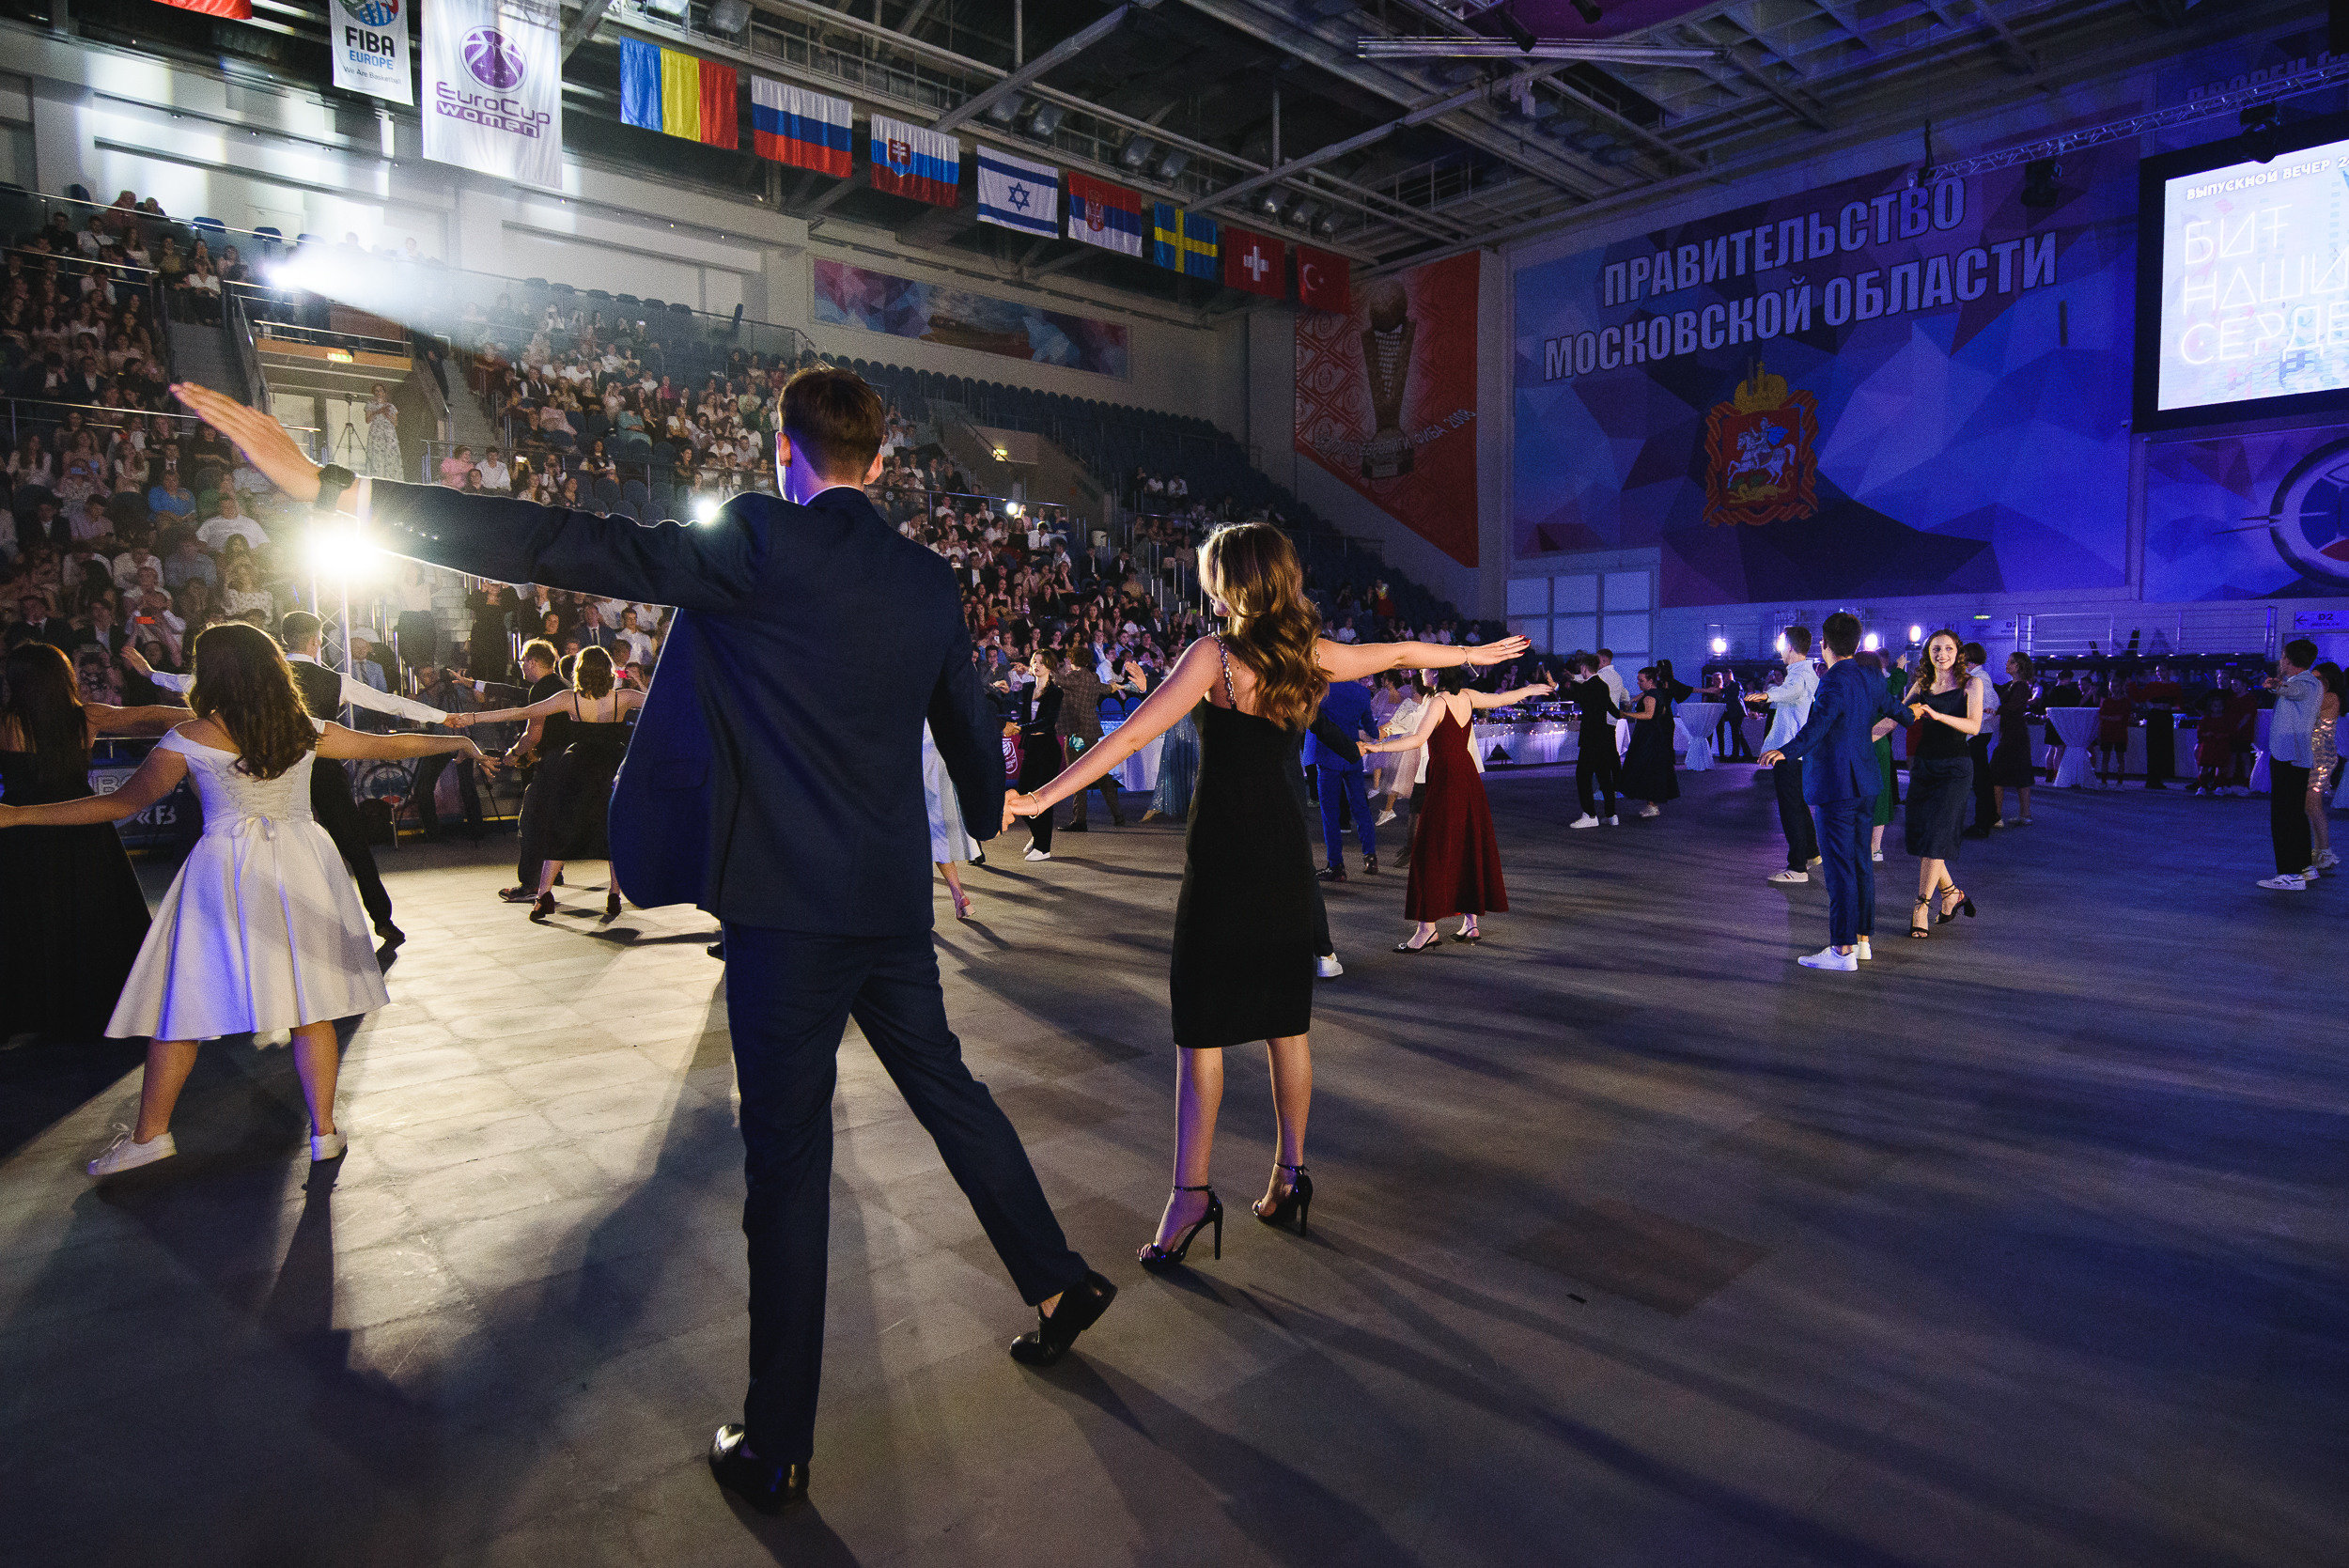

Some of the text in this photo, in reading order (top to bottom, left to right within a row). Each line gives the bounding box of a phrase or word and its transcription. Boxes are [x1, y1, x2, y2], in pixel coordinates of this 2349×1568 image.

[345, 25, 395, 57] FIBA
[350, 50, 394, 70] EUROPE
[343, 65, 401, 85] We Are Basketball
[437, 81, 551, 125] EuroCup
[439, 101, 538, 138] women
[2186, 156, 2349, 201] ВЫПУСКНОЙ ВЕЧЕР 2
[1604, 177, 1966, 306] ПРАВИТЕЛЬСТВО
[2185, 204, 2293, 265] БИТ
[2183, 245, 2349, 317] НАШИ
[1544, 231, 2057, 381] МОСКОВСКОЙ ОБЛАСТИ
[1359, 436, 1411, 457] ЕВРОЛИГИ
[1414, 423, 1449, 444] ФИБА
[1443, 408, 1476, 428] 2008
